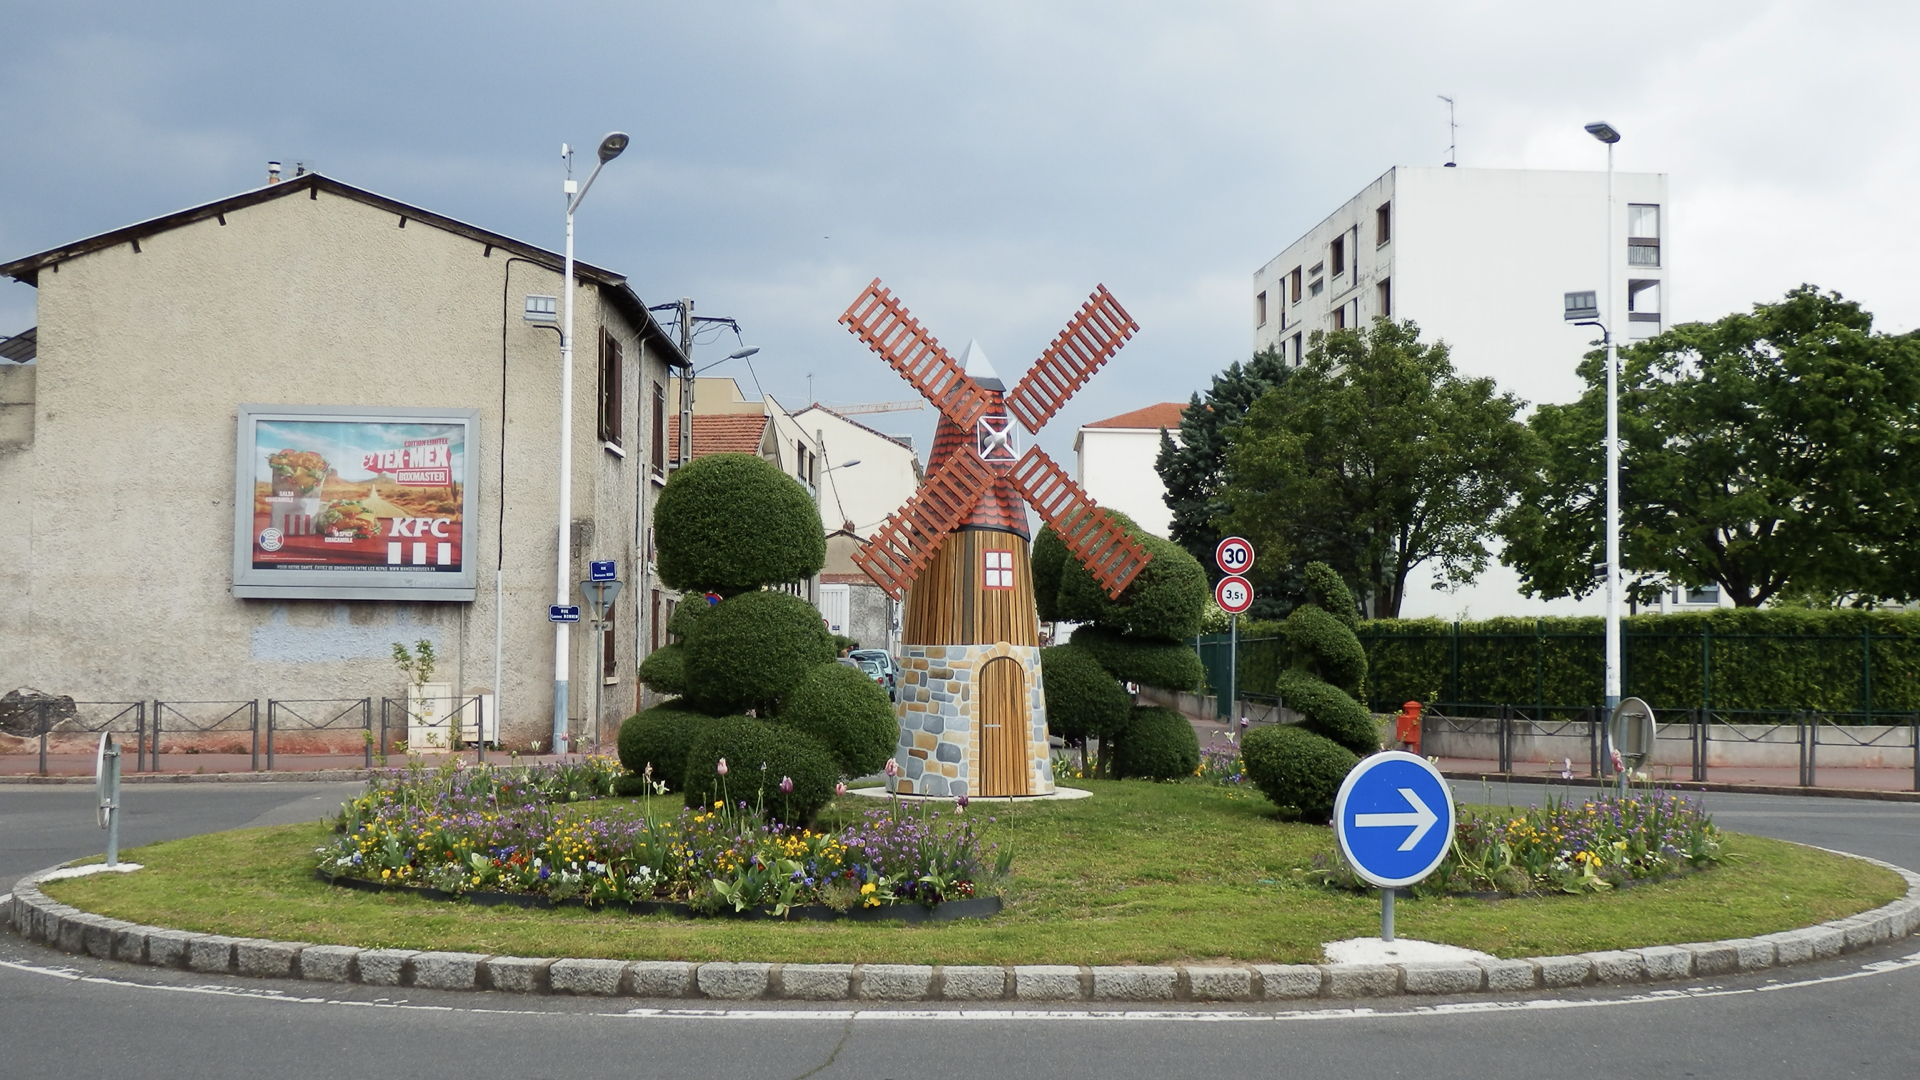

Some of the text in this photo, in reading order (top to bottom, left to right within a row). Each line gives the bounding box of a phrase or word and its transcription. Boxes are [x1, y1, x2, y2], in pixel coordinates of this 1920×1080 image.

[376, 445, 449, 469] TEX-MEX
[398, 471, 445, 481] BOXMASTER
[388, 517, 451, 538] KFC
[1224, 548, 1246, 564] 30
